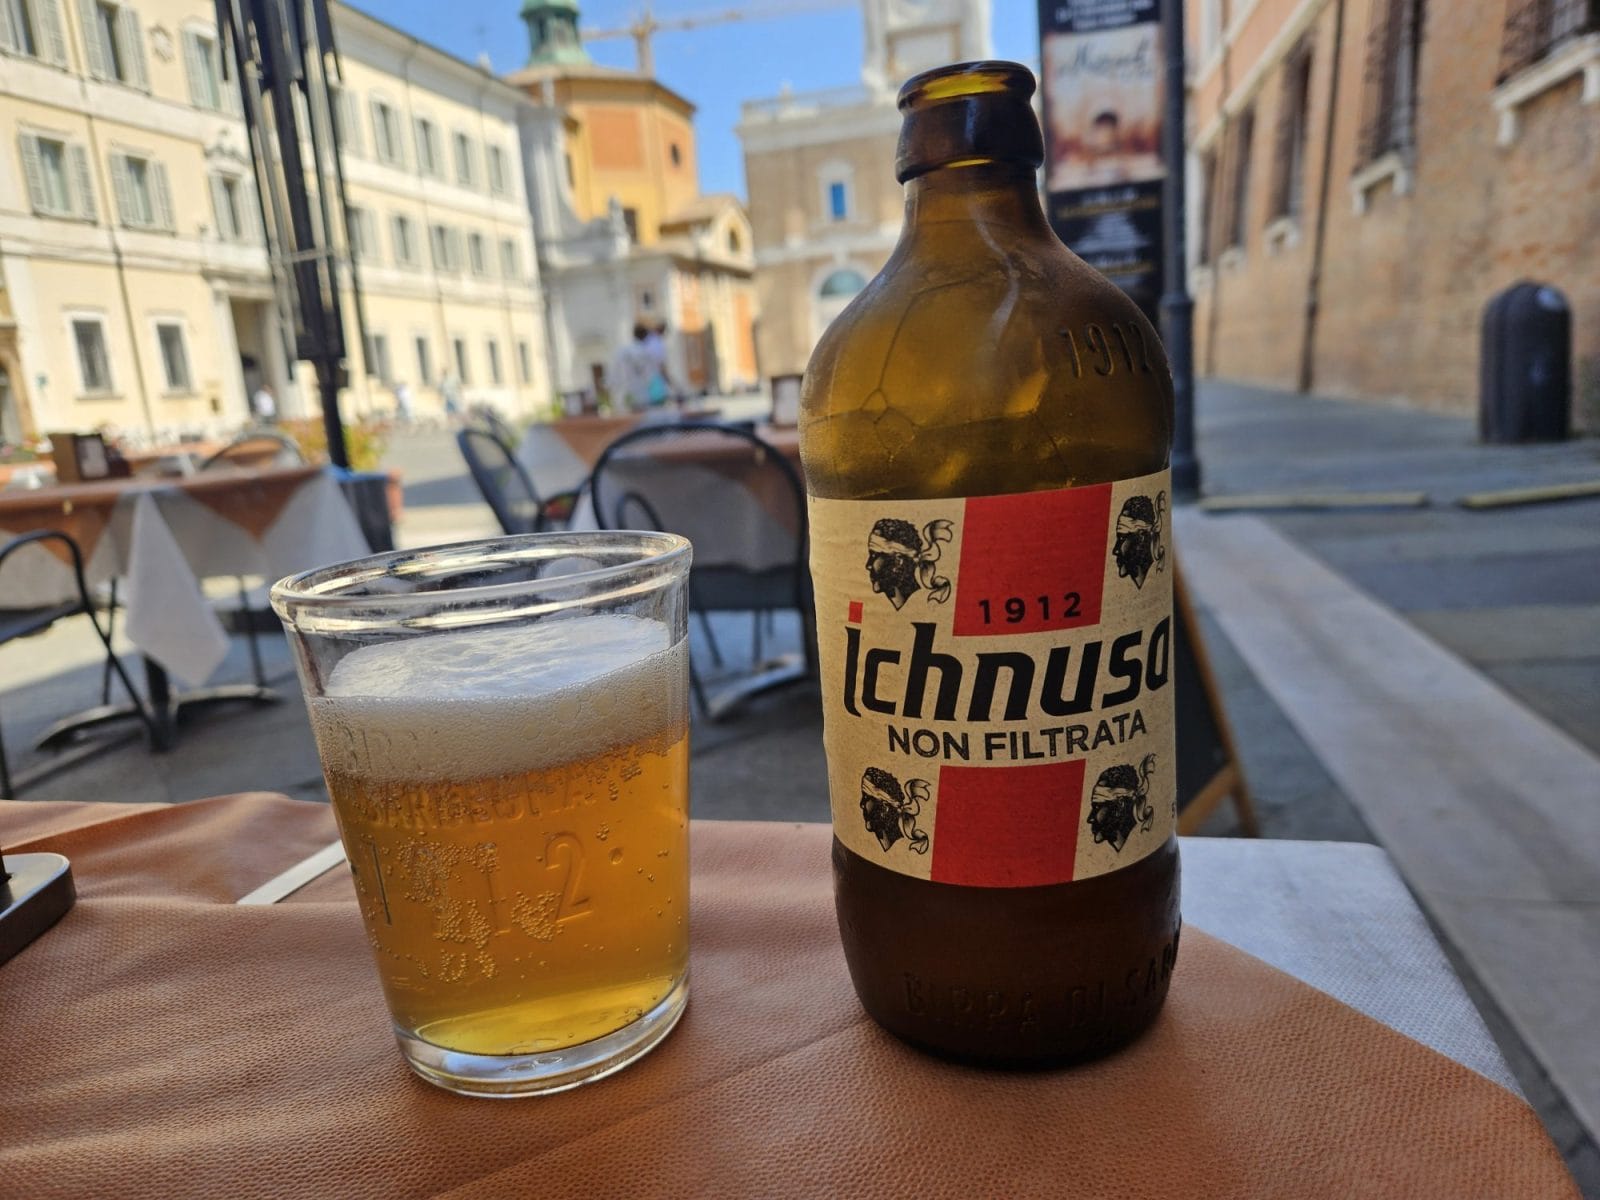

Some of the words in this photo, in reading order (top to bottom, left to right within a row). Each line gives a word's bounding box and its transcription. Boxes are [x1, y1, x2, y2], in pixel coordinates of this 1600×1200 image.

[978, 591, 1083, 625] 1912
[843, 601, 1171, 722] ichnusa
[887, 725, 970, 761] NON
[984, 709, 1148, 761] FILTRATA
